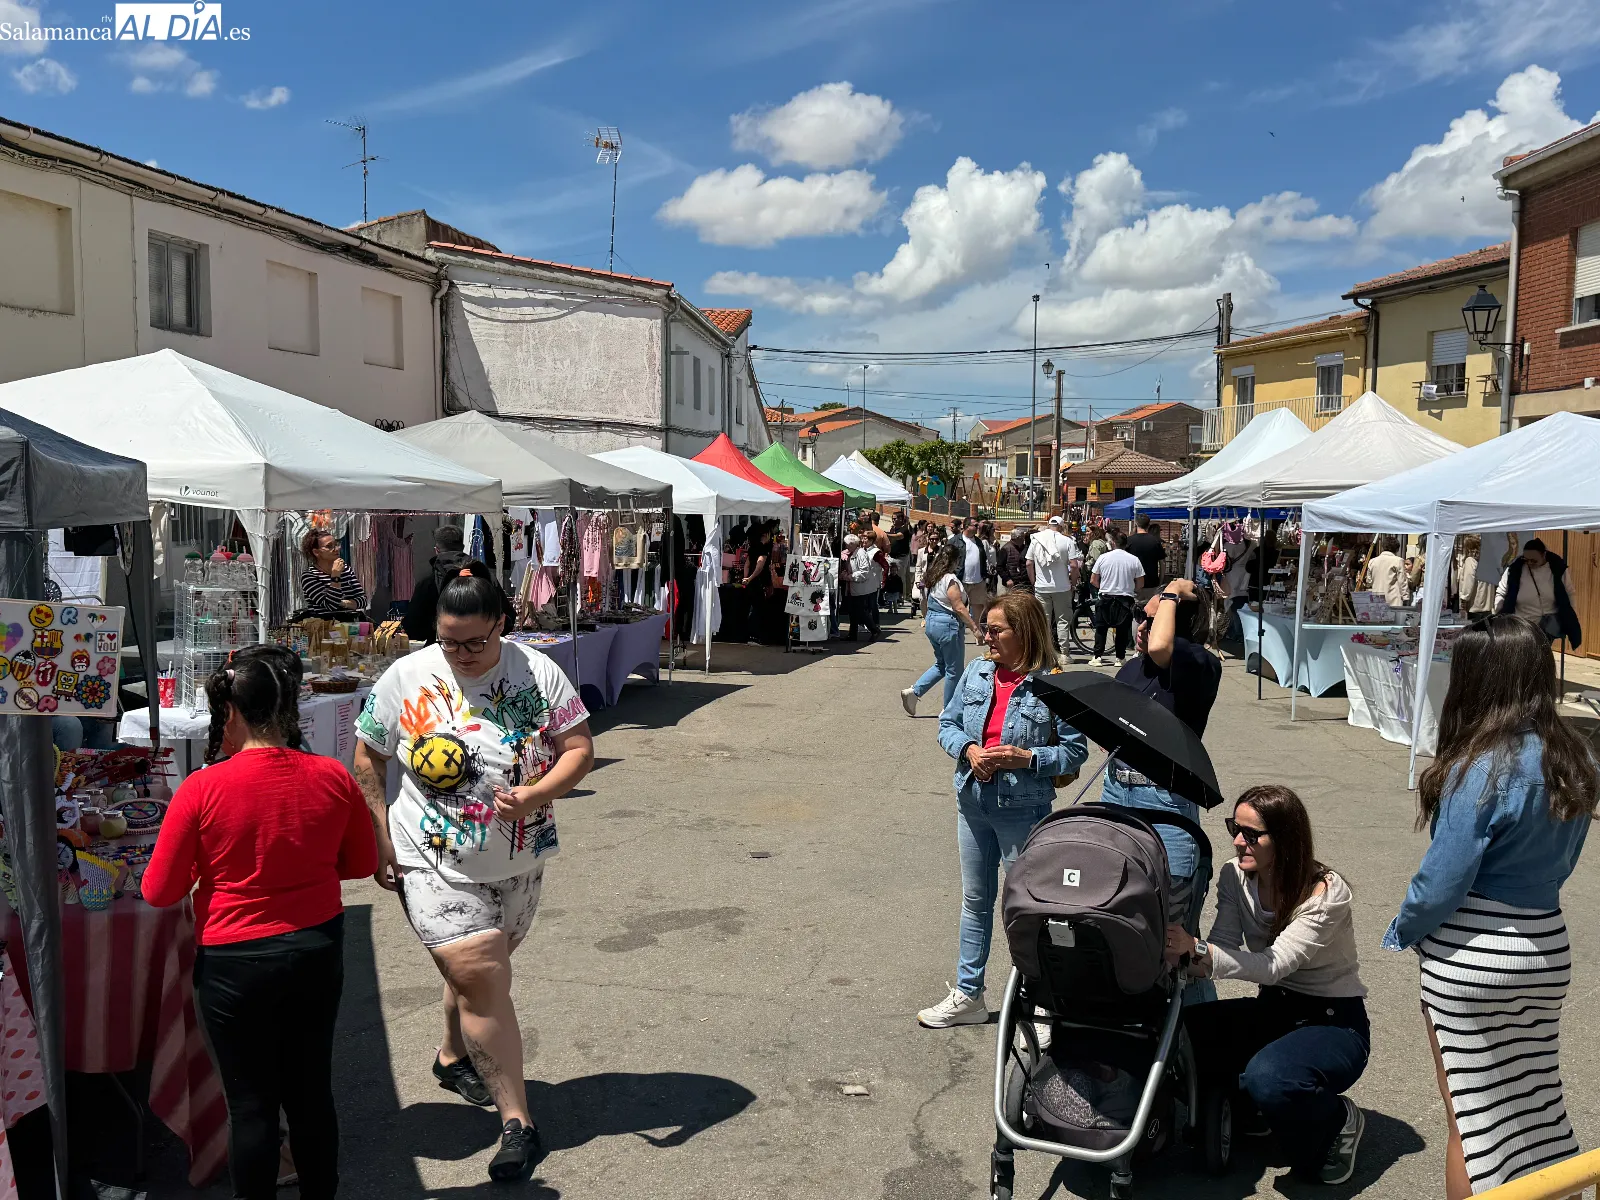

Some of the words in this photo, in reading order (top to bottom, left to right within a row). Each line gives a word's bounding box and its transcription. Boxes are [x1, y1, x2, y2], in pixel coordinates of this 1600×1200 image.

[97, 632, 106, 642] I
[97, 642, 117, 652] YOU
[1068, 872, 1076, 883] C
